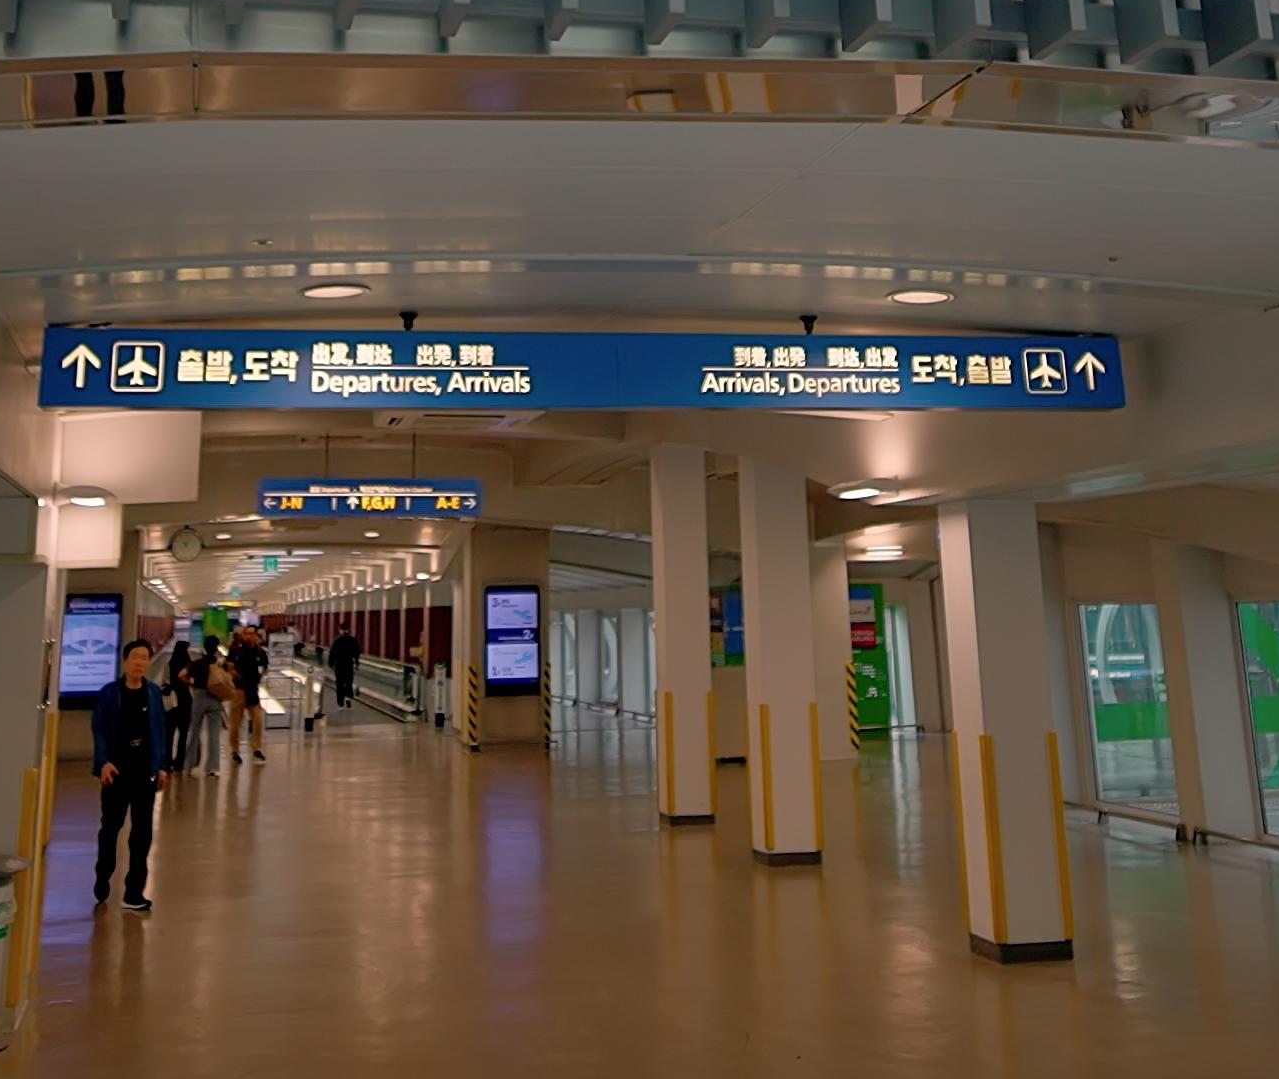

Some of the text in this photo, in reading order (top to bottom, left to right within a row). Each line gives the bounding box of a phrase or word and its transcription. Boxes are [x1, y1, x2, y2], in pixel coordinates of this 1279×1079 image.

[242, 349, 301, 382] 도착
[310, 372, 531, 398] Departures, Arrivals
